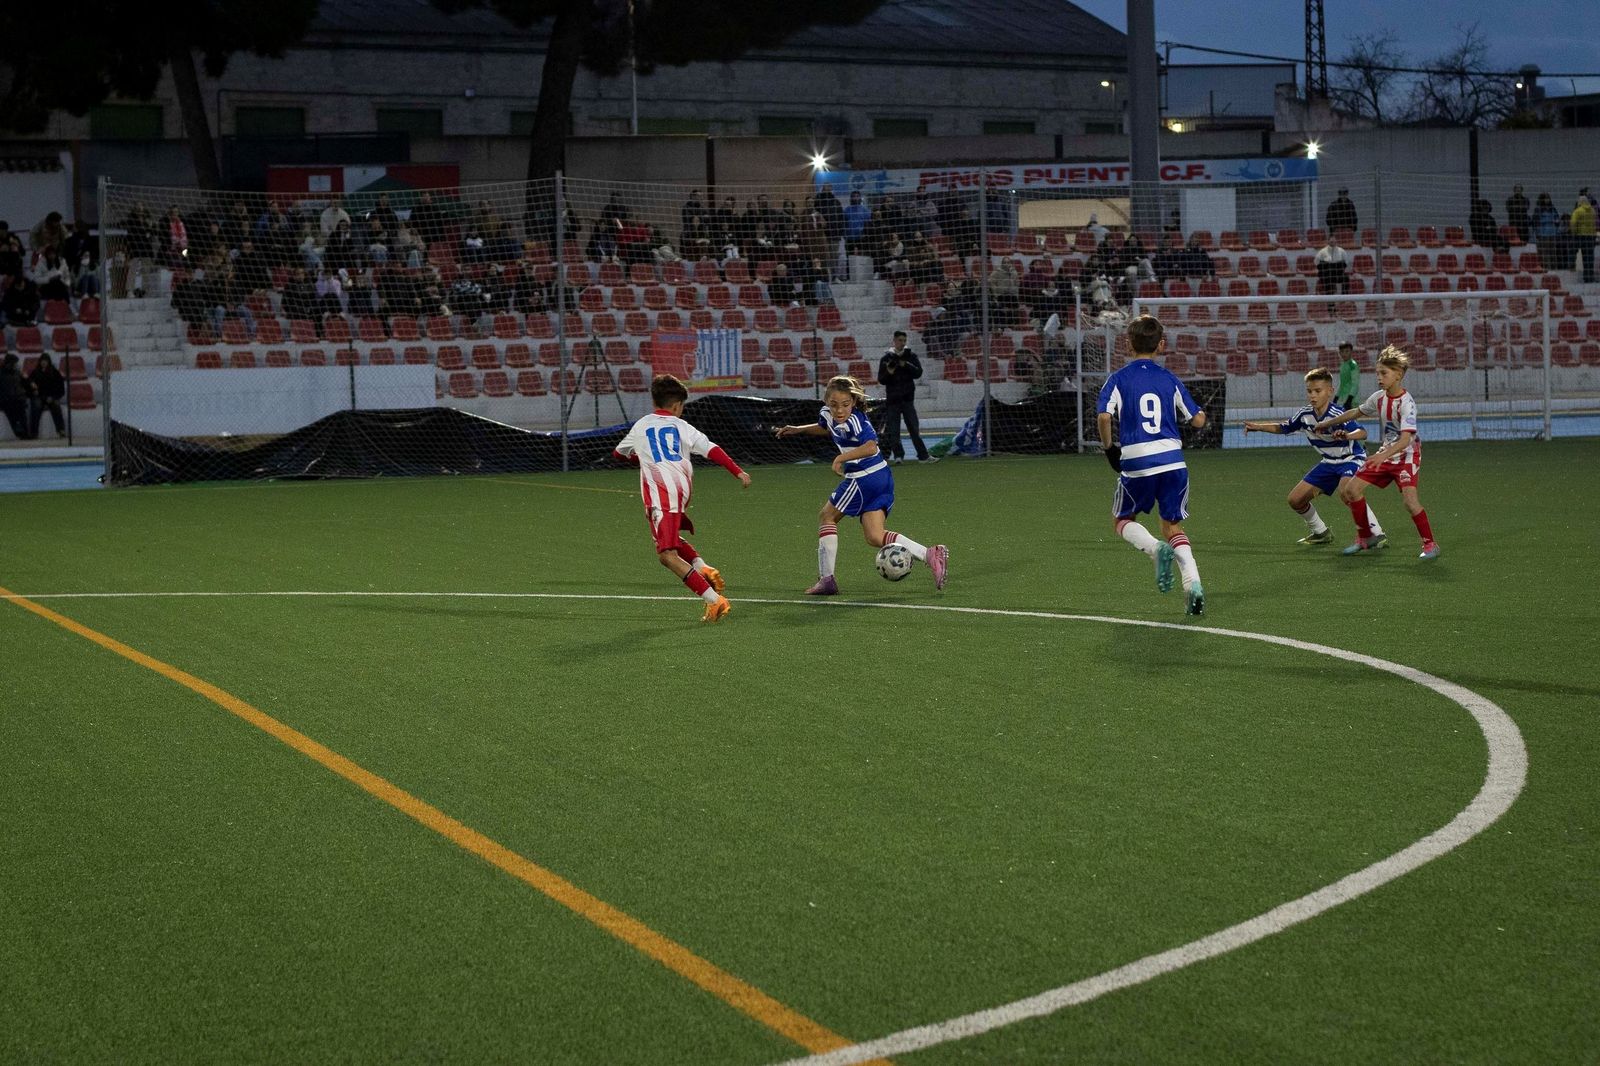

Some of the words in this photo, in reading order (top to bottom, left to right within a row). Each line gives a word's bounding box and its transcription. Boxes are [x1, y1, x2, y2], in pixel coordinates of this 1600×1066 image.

[919, 169, 1014, 188] PINOS
[1023, 165, 1130, 185] PUENT
[1160, 164, 1212, 181] C.F.
[1139, 392, 1162, 435] 9
[645, 426, 683, 464] 10
